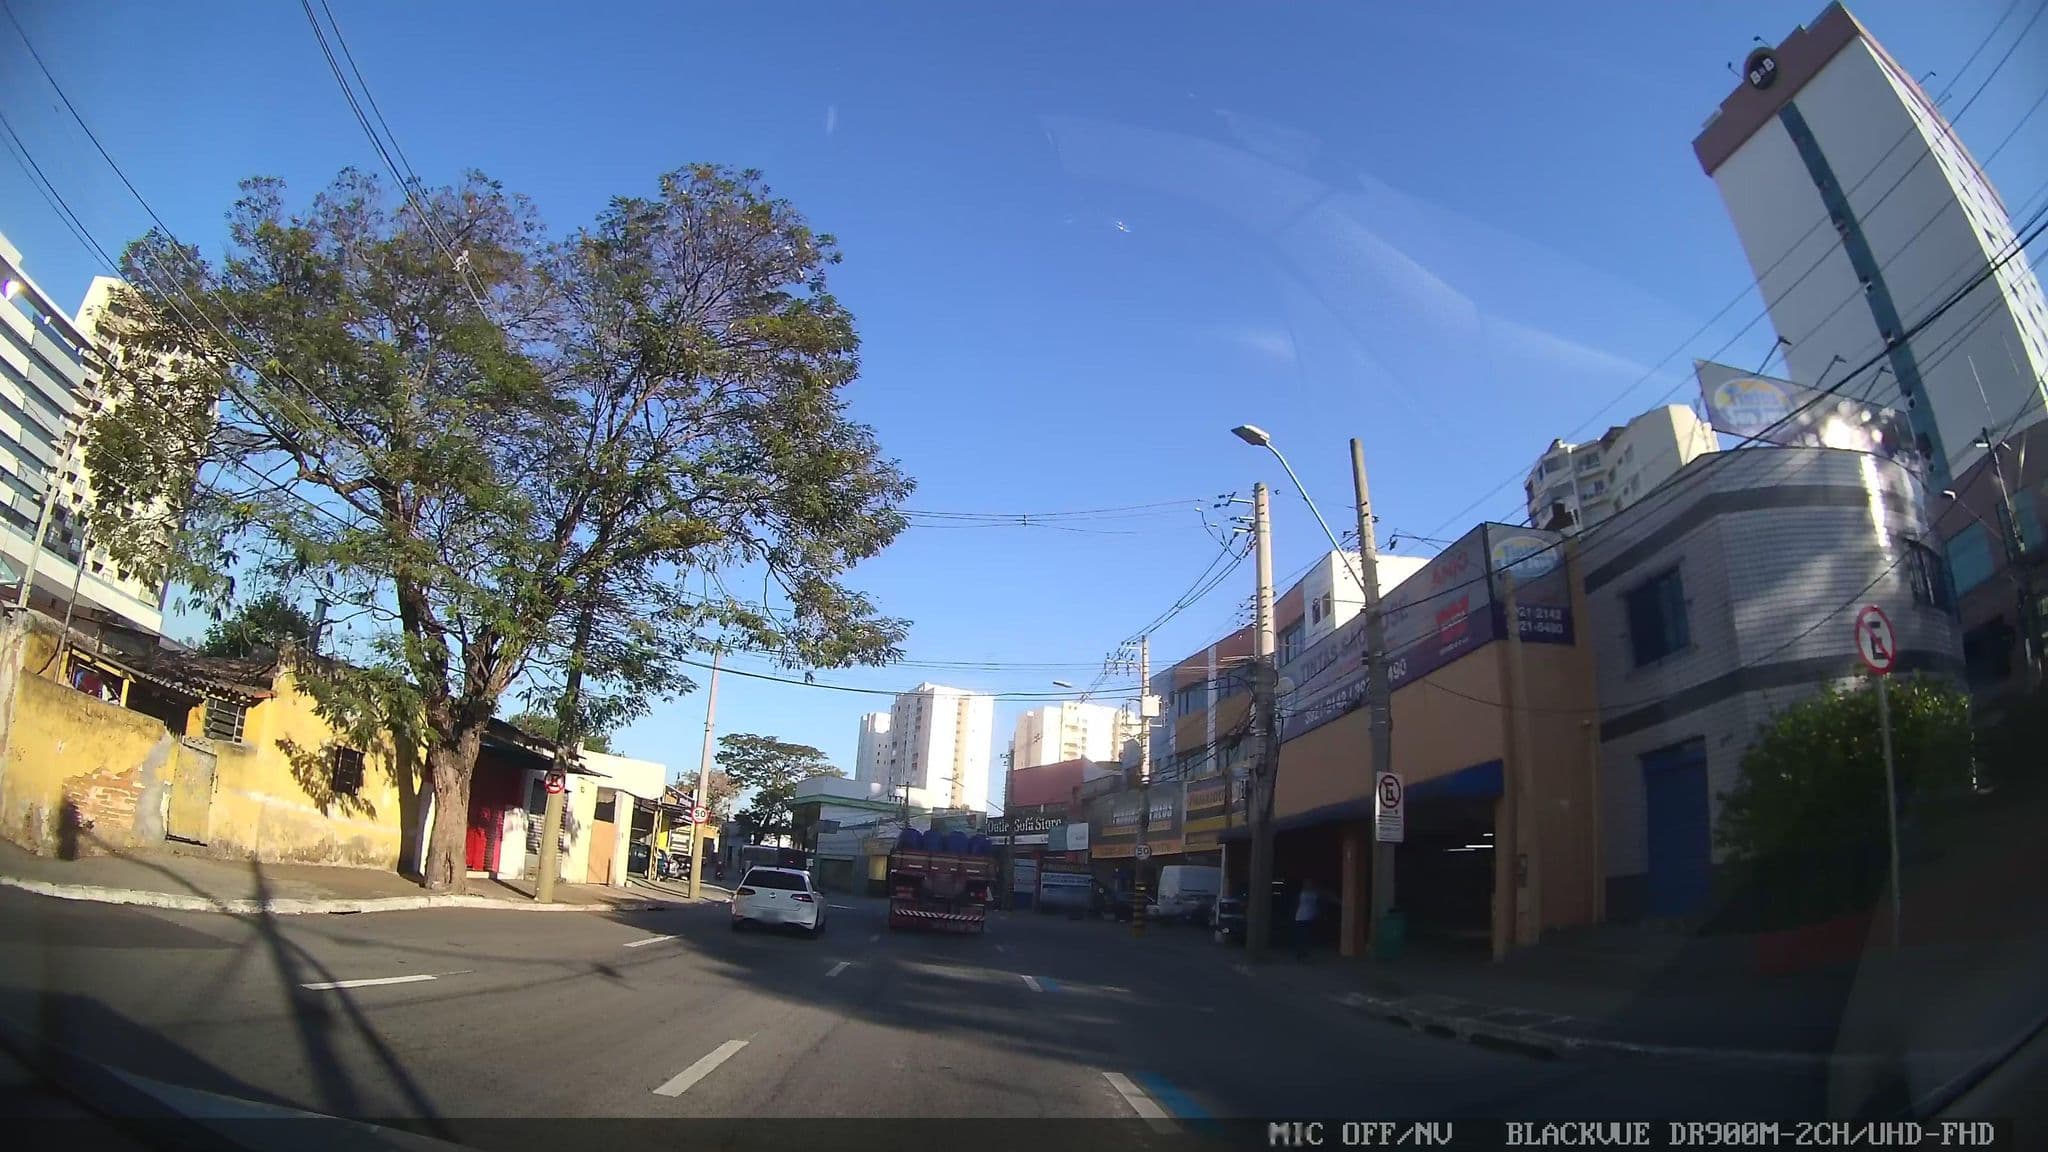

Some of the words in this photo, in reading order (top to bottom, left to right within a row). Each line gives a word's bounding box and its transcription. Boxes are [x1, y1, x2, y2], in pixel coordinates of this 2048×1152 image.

[695, 809, 706, 818] 50
[1014, 817, 1034, 832] Sofá
[1137, 847, 1149, 855] 50
